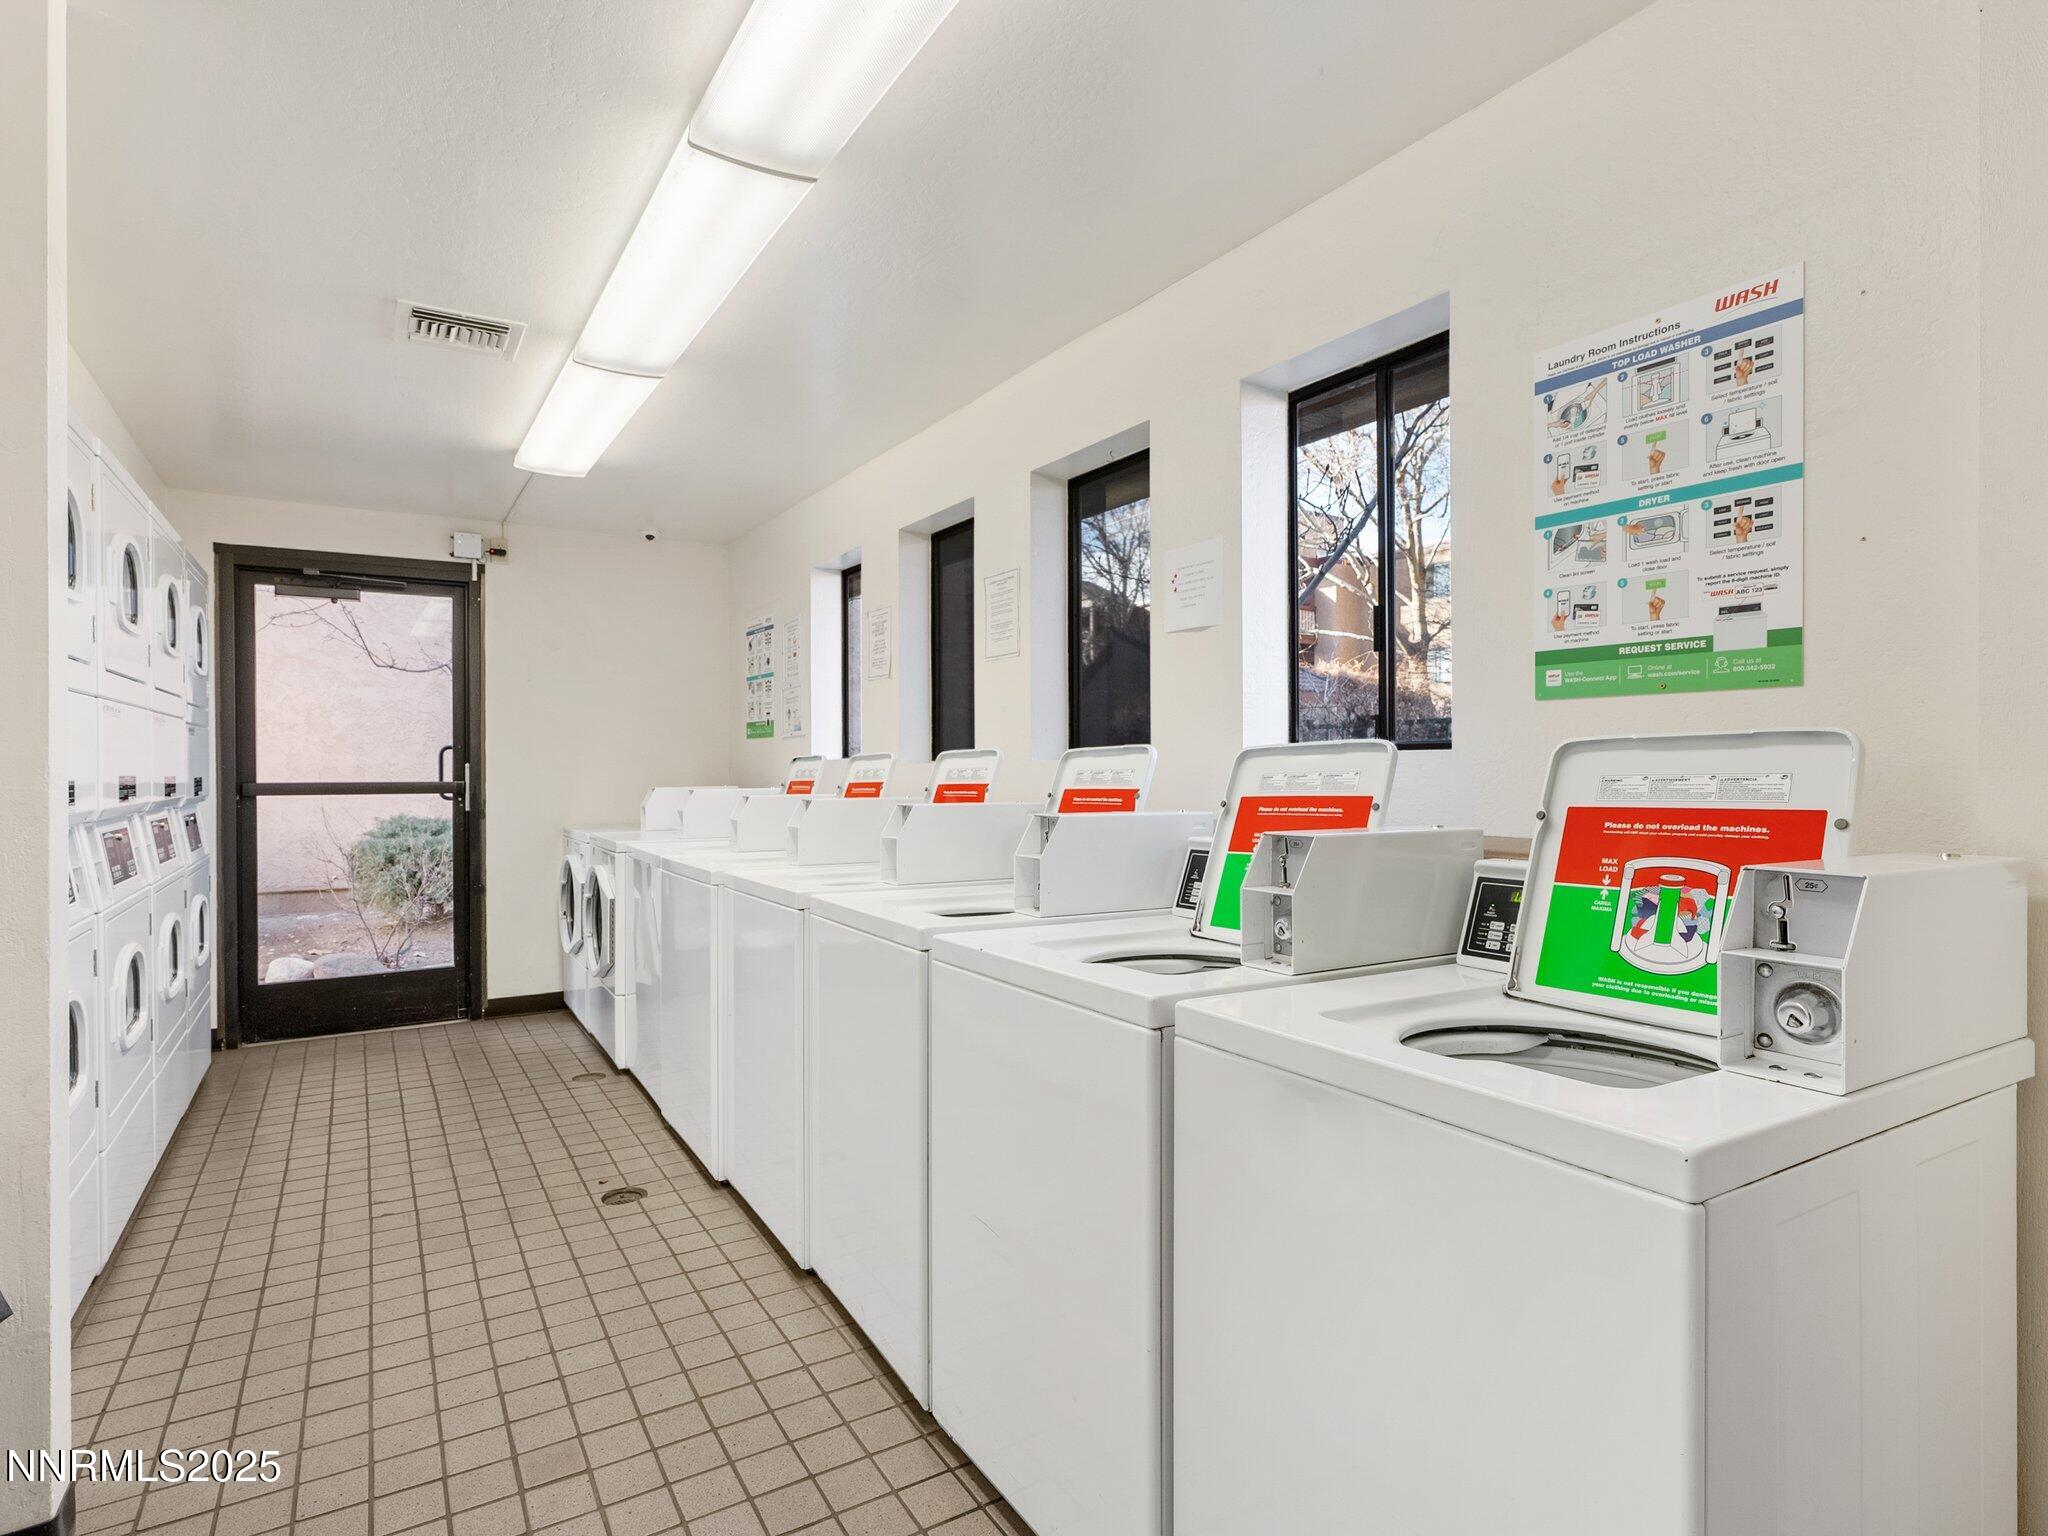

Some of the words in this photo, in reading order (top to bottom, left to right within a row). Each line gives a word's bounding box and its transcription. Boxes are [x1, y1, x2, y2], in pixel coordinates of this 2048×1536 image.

[1714, 278, 1779, 313] WASH
[1547, 351, 1585, 372] Laundry
[1588, 340, 1616, 358] Room
[1619, 319, 1680, 348] Instructions
[1611, 356, 1630, 370] TOP
[1632, 347, 1657, 363] LOAD
[1659, 334, 1701, 355] WASHER
[1655, 414, 1667, 422] MAX
[1638, 494, 1670, 507] DRYER
[1747, 567, 1769, 575] request,
[1770, 564, 1789, 572] simply
[1710, 588, 1733, 596] WASH
[1618, 643, 1662, 654] REQUEST
[1664, 639, 1706, 651] SERVICE
[1647, 668, 1700, 678] wash.com/service
[1662, 823, 1701, 831] overload
[1703, 824, 1718, 832] the
[1719, 825, 1770, 833] machines.
[1601, 857, 1619, 865] MAX
[1598, 865, 1619, 873] LOAD
[1597, 976, 1616, 984] WASH
[1634, 982, 1670, 993] responsible
[1605, 983, 1630, 993] clothing
[1630, 986, 1643, 994] due
[1651, 990, 1689, 1002] overloading
